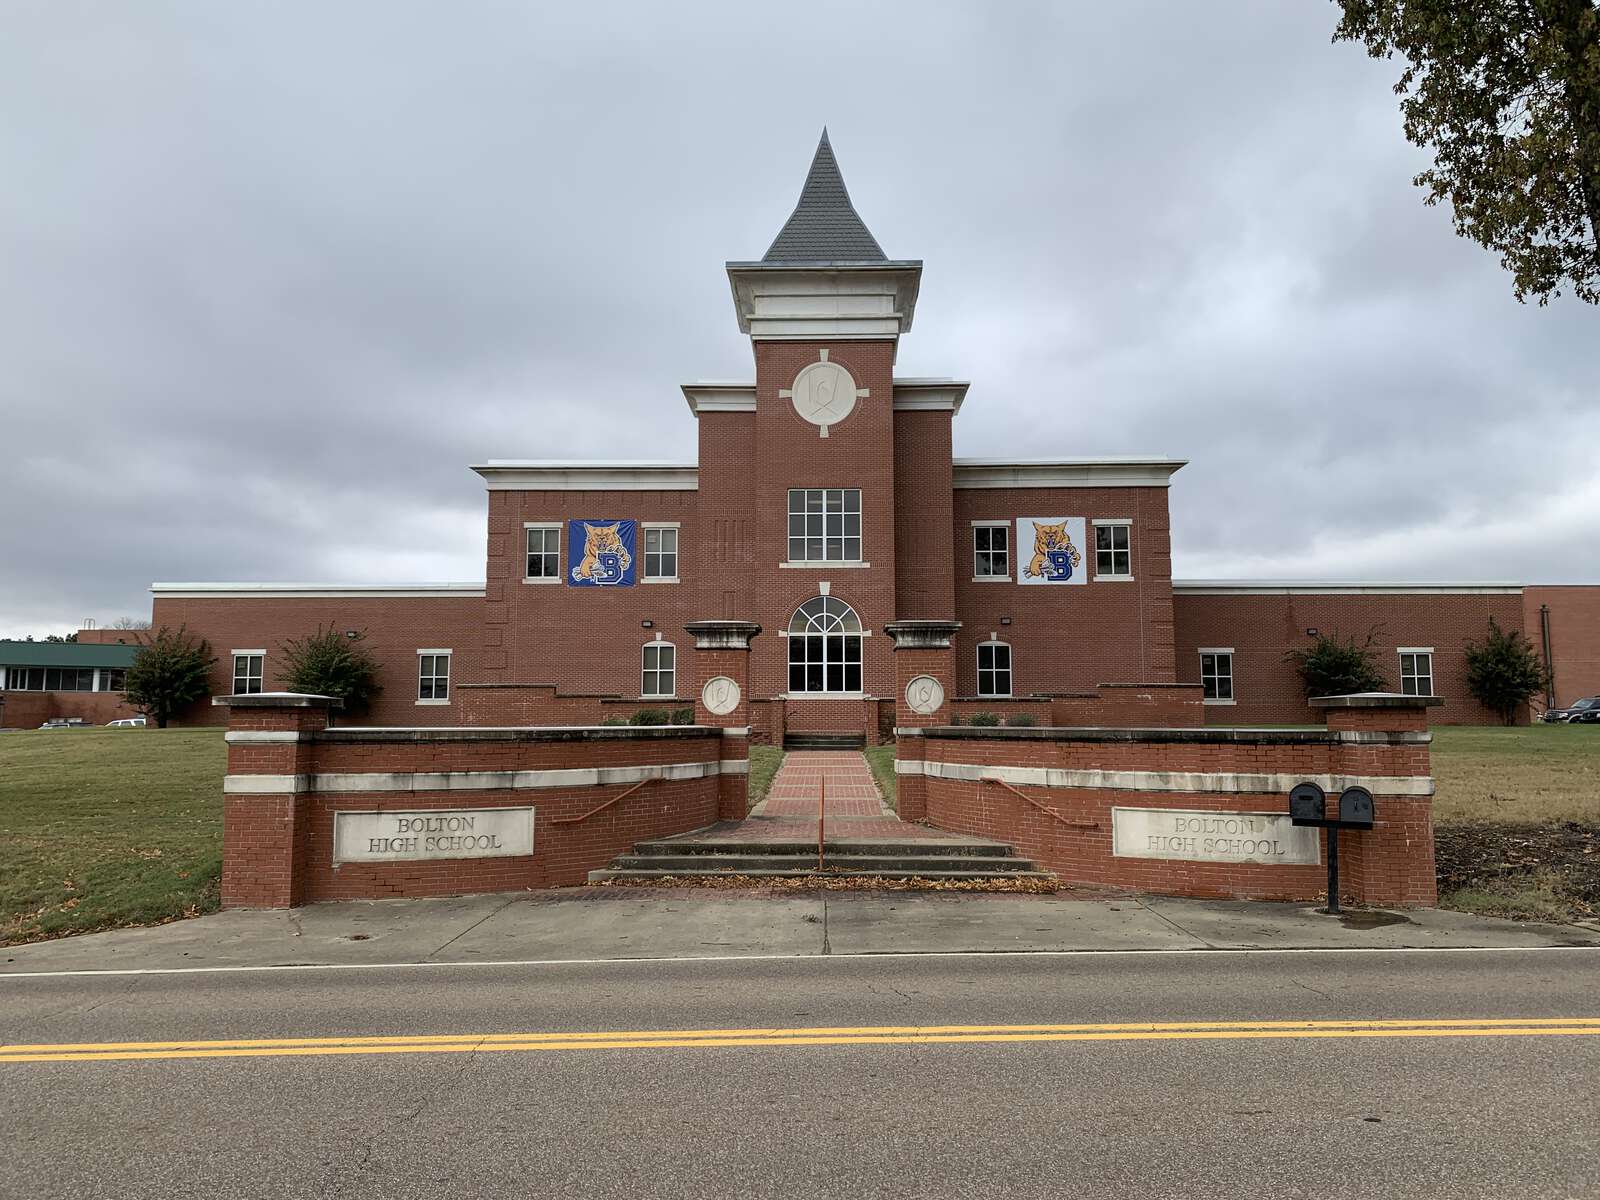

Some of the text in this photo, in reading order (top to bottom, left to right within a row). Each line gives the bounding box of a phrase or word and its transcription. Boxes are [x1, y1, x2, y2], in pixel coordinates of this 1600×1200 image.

[596, 551, 623, 584] B
[1047, 551, 1072, 581] B
[398, 817, 475, 833] BOLTON
[1175, 817, 1254, 834] BOLTON
[368, 835, 502, 853] HIGH SCHOOL
[1147, 836, 1285, 855] HIGH SCHOOL
